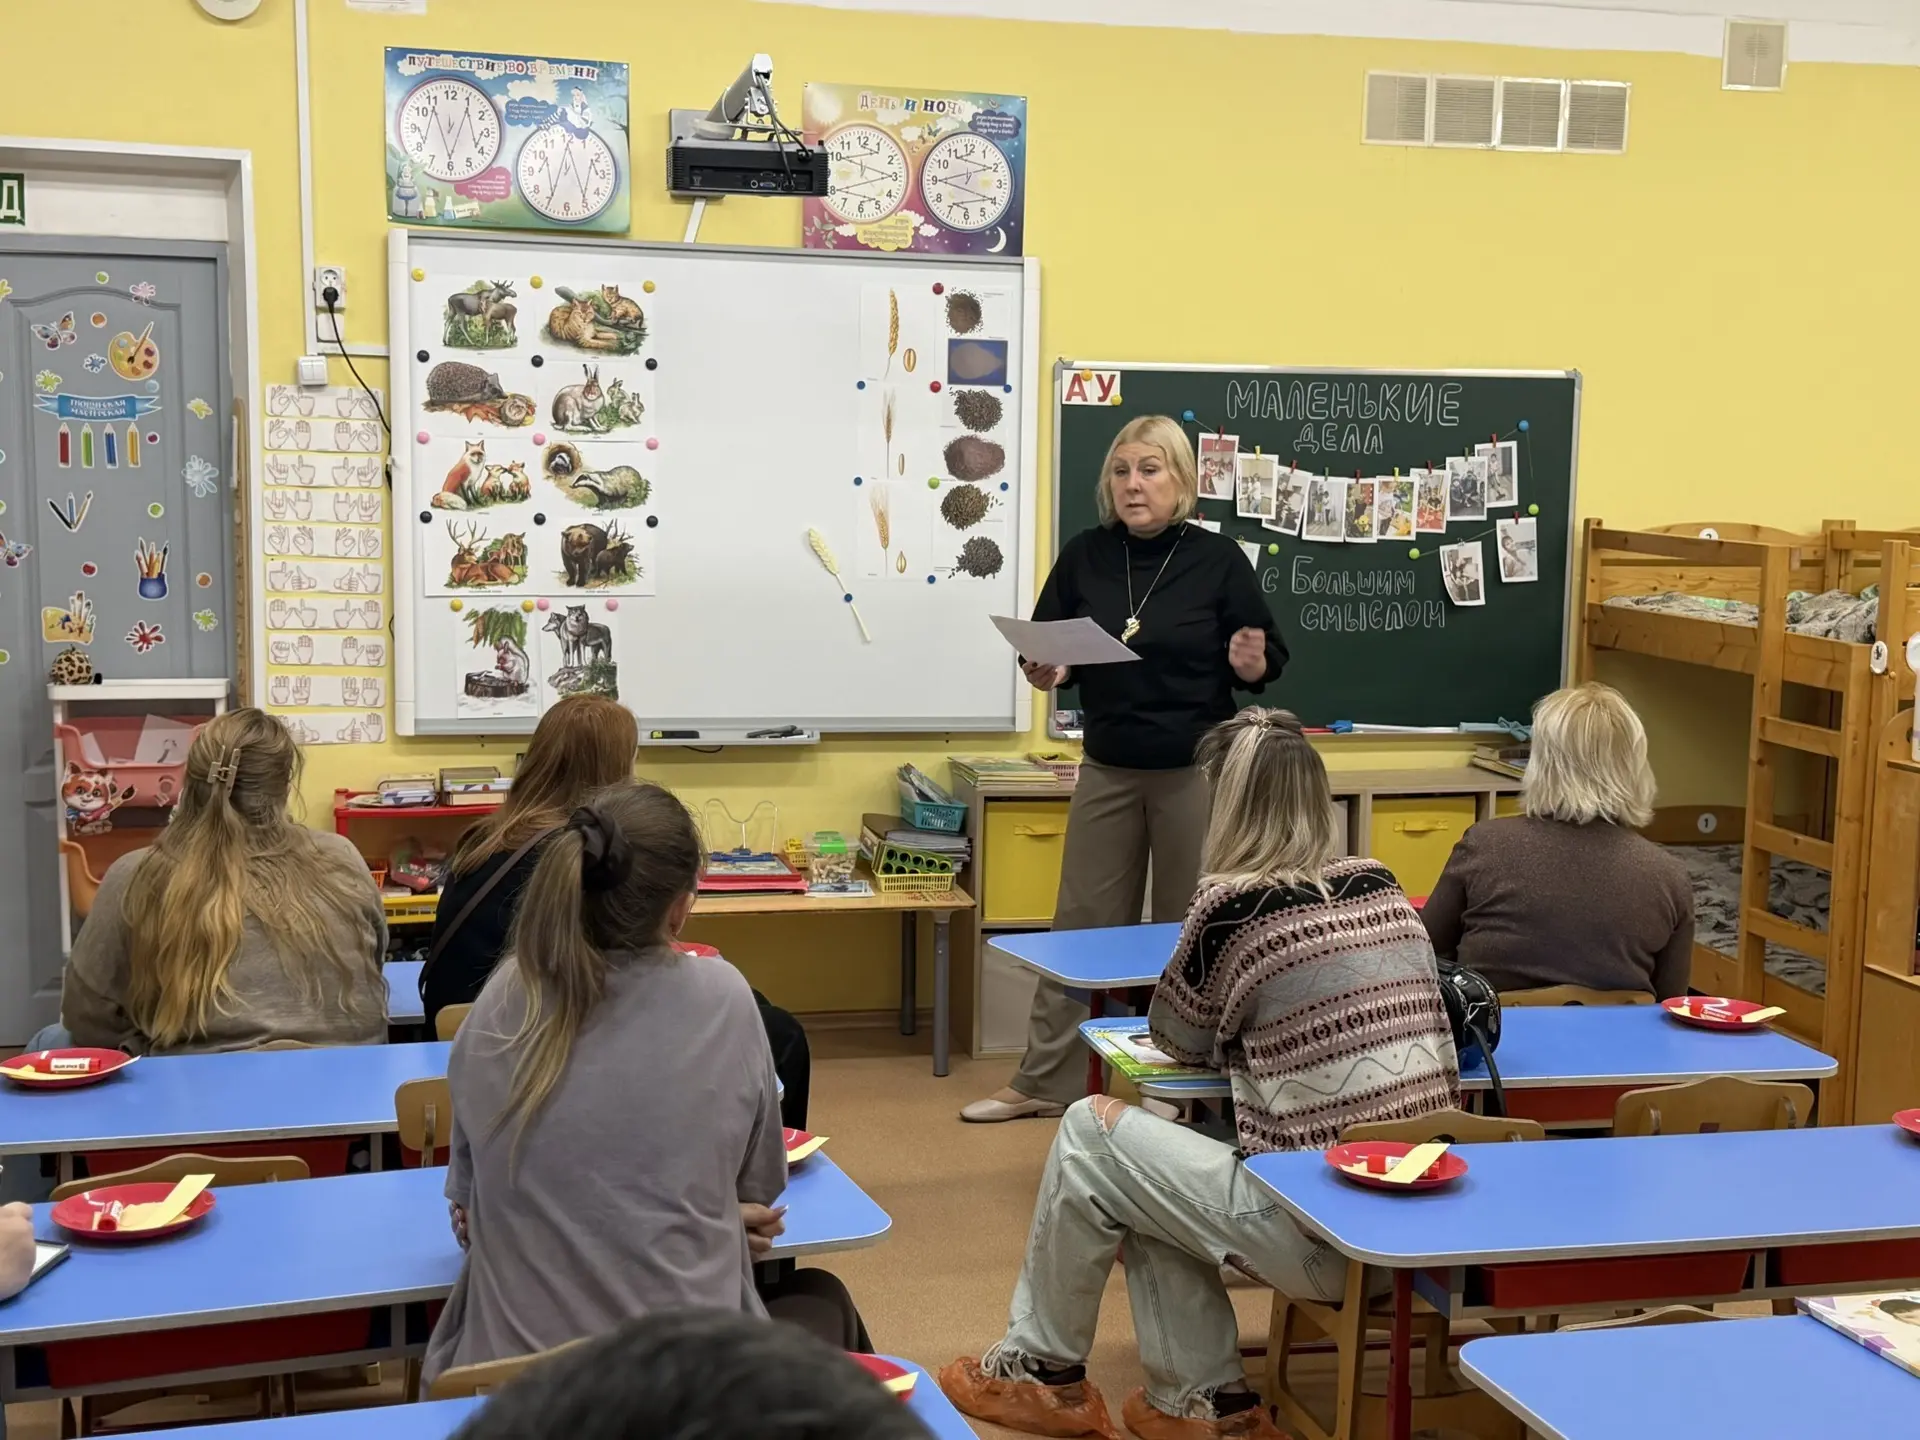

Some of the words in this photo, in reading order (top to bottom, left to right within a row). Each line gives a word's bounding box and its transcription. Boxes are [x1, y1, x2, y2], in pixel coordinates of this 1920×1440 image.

[508, 61, 524, 73] ВО
[530, 63, 596, 79] ВРЕМЕНИ
[426, 95, 438, 106] 11
[444, 90, 458, 101] 12
[465, 96, 470, 106] 1
[860, 95, 897, 110] ДЕНЬ
[904, 98, 918, 113] И
[923, 99, 965, 115] НОЧЬ
[415, 106, 429, 117] 10
[478, 110, 485, 121] 2
[410, 123, 417, 134] 9
[483, 128, 490, 138] 3
[560, 133, 574, 144] 12
[857, 136, 869, 146] 12
[416, 142, 423, 152] 8
[544, 139, 555, 149] 11
[582, 140, 586, 149] 1
[840, 141, 851, 151] 11
[876, 142, 880, 152] 1
[964, 144, 976, 154] 12
[477, 146, 485, 157] 4
[533, 150, 546, 160] 10
[830, 151, 842, 162] 10
[947, 148, 959, 159] 11
[982, 149, 986, 159] 1
[428, 154, 436, 166] 7
[465, 157, 472, 168] 5
[594, 153, 601, 163] 2
[887, 155, 894, 165] 2
[447, 161, 454, 172] 6
[937, 159, 949, 169] 10
[992, 163, 999, 173] 2
[527, 166, 534, 176] 9
[599, 169, 606, 180] 3
[891, 172, 898, 182] 3
[931, 175, 938, 185] 9
[996, 179, 1003, 189] 3
[533, 184, 540, 195] 8
[593, 187, 600, 197] 4
[830, 185, 837, 195] 8
[886, 189, 892, 199] 4
[546, 196, 553, 210] 7
[841, 197, 848, 208] 7
[936, 193, 942, 203] 8
[990, 196, 997, 206] 4
[563, 202, 570, 212] 6
[581, 198, 589, 209] 5
[857, 201, 864, 213] 6
[874, 200, 881, 210] 5
[947, 205, 953, 216] 7
[963, 209, 970, 220] 6
[980, 207, 986, 217] 5
[1065, 373, 1116, 402] АУ
[1226, 379, 1463, 426] МАЛЕНЬКИЕ
[1293, 423, 1384, 454] ДЕЛА
